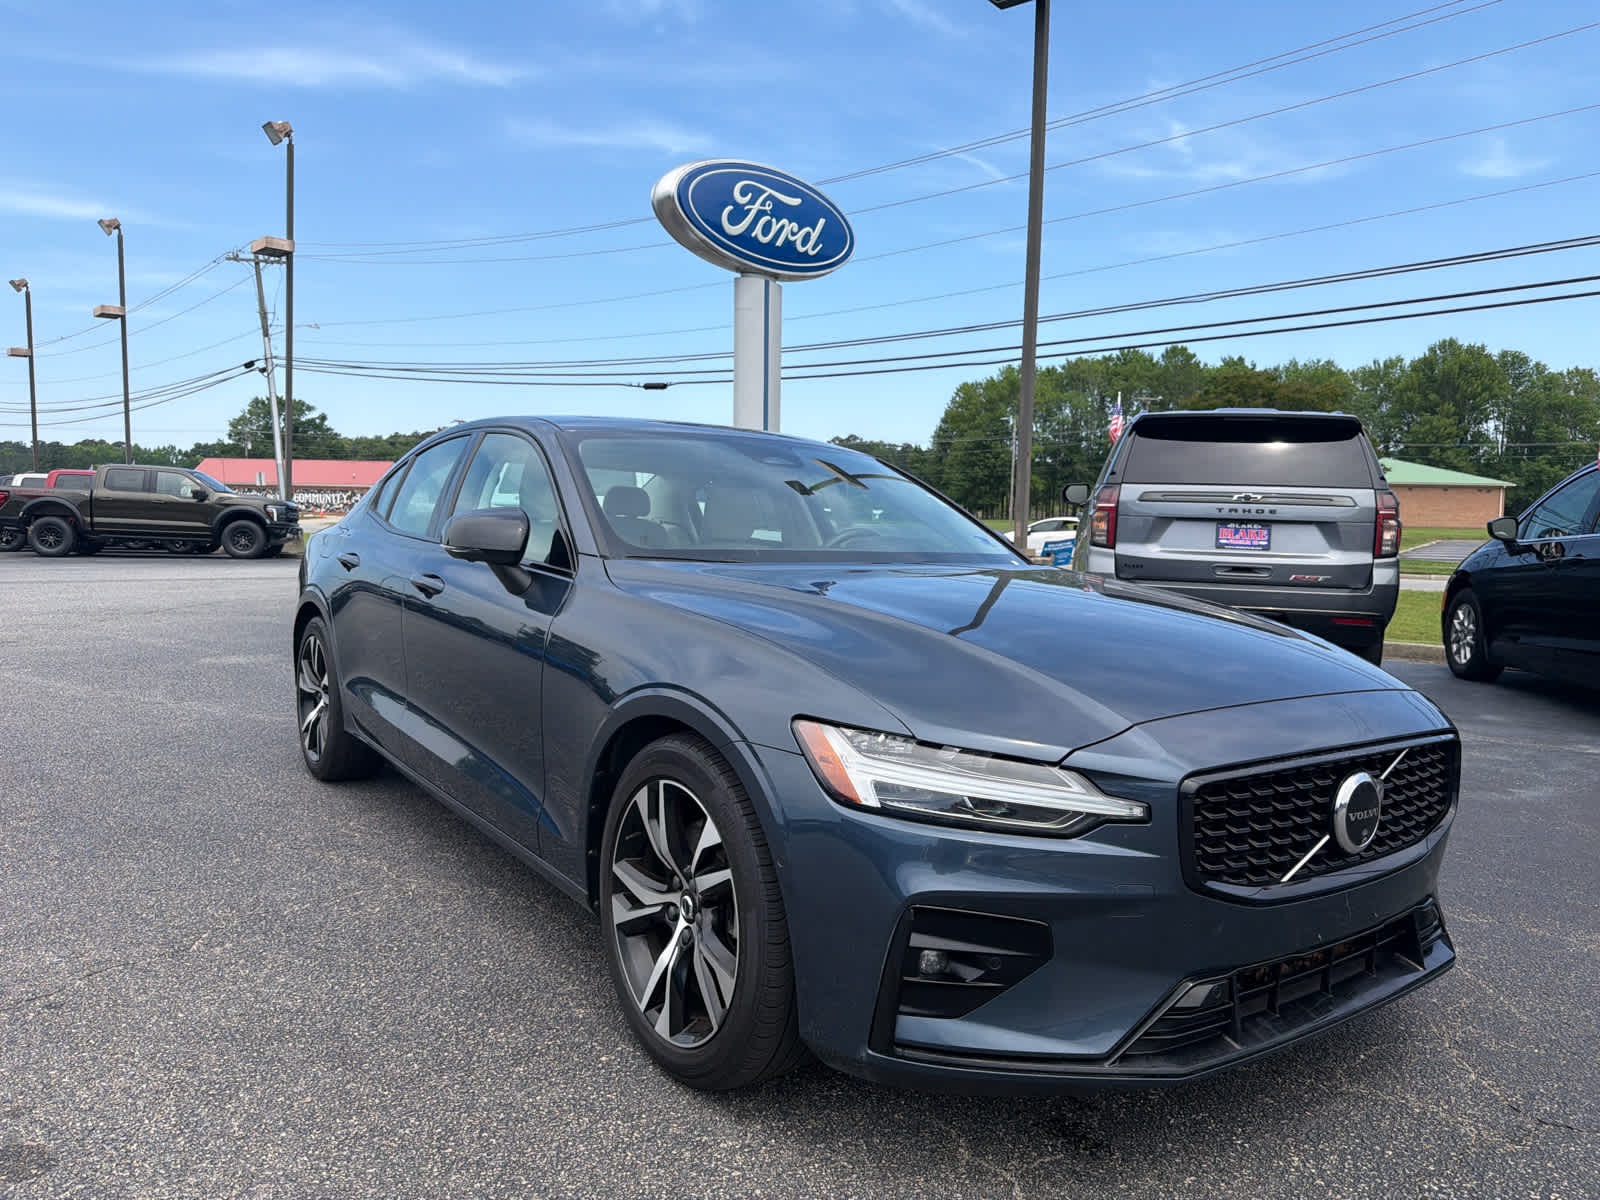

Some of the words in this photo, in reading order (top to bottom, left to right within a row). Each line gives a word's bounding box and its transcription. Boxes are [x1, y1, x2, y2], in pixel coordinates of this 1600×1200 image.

[721, 180, 826, 256] Ford
[293, 493, 348, 505] COMMUNITY
[1219, 528, 1269, 541] BLAKE
